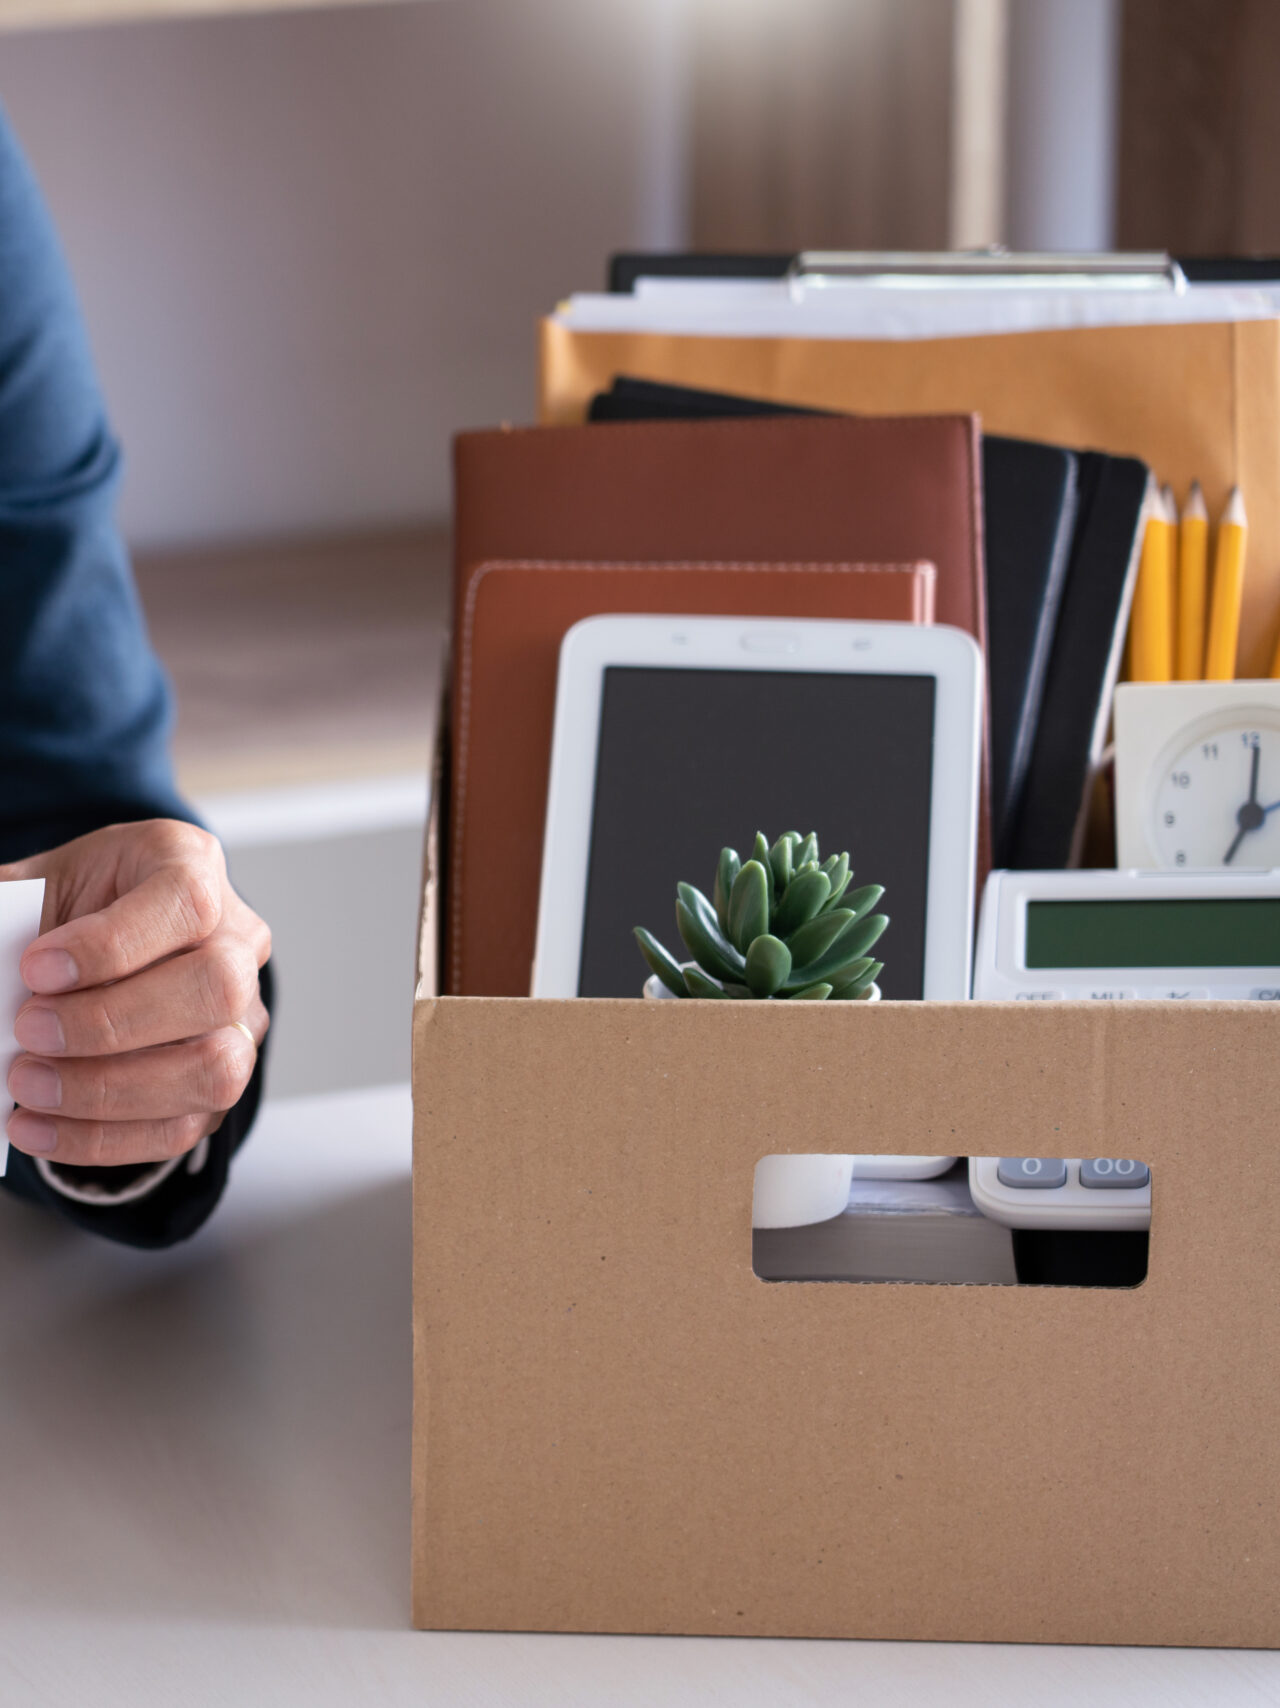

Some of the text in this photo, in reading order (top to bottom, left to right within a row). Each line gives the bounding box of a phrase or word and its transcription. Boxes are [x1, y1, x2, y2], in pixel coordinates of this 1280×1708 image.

[1241, 731, 1261, 748] 12
[1202, 743, 1219, 760] 11
[1171, 771, 1191, 789] 10
